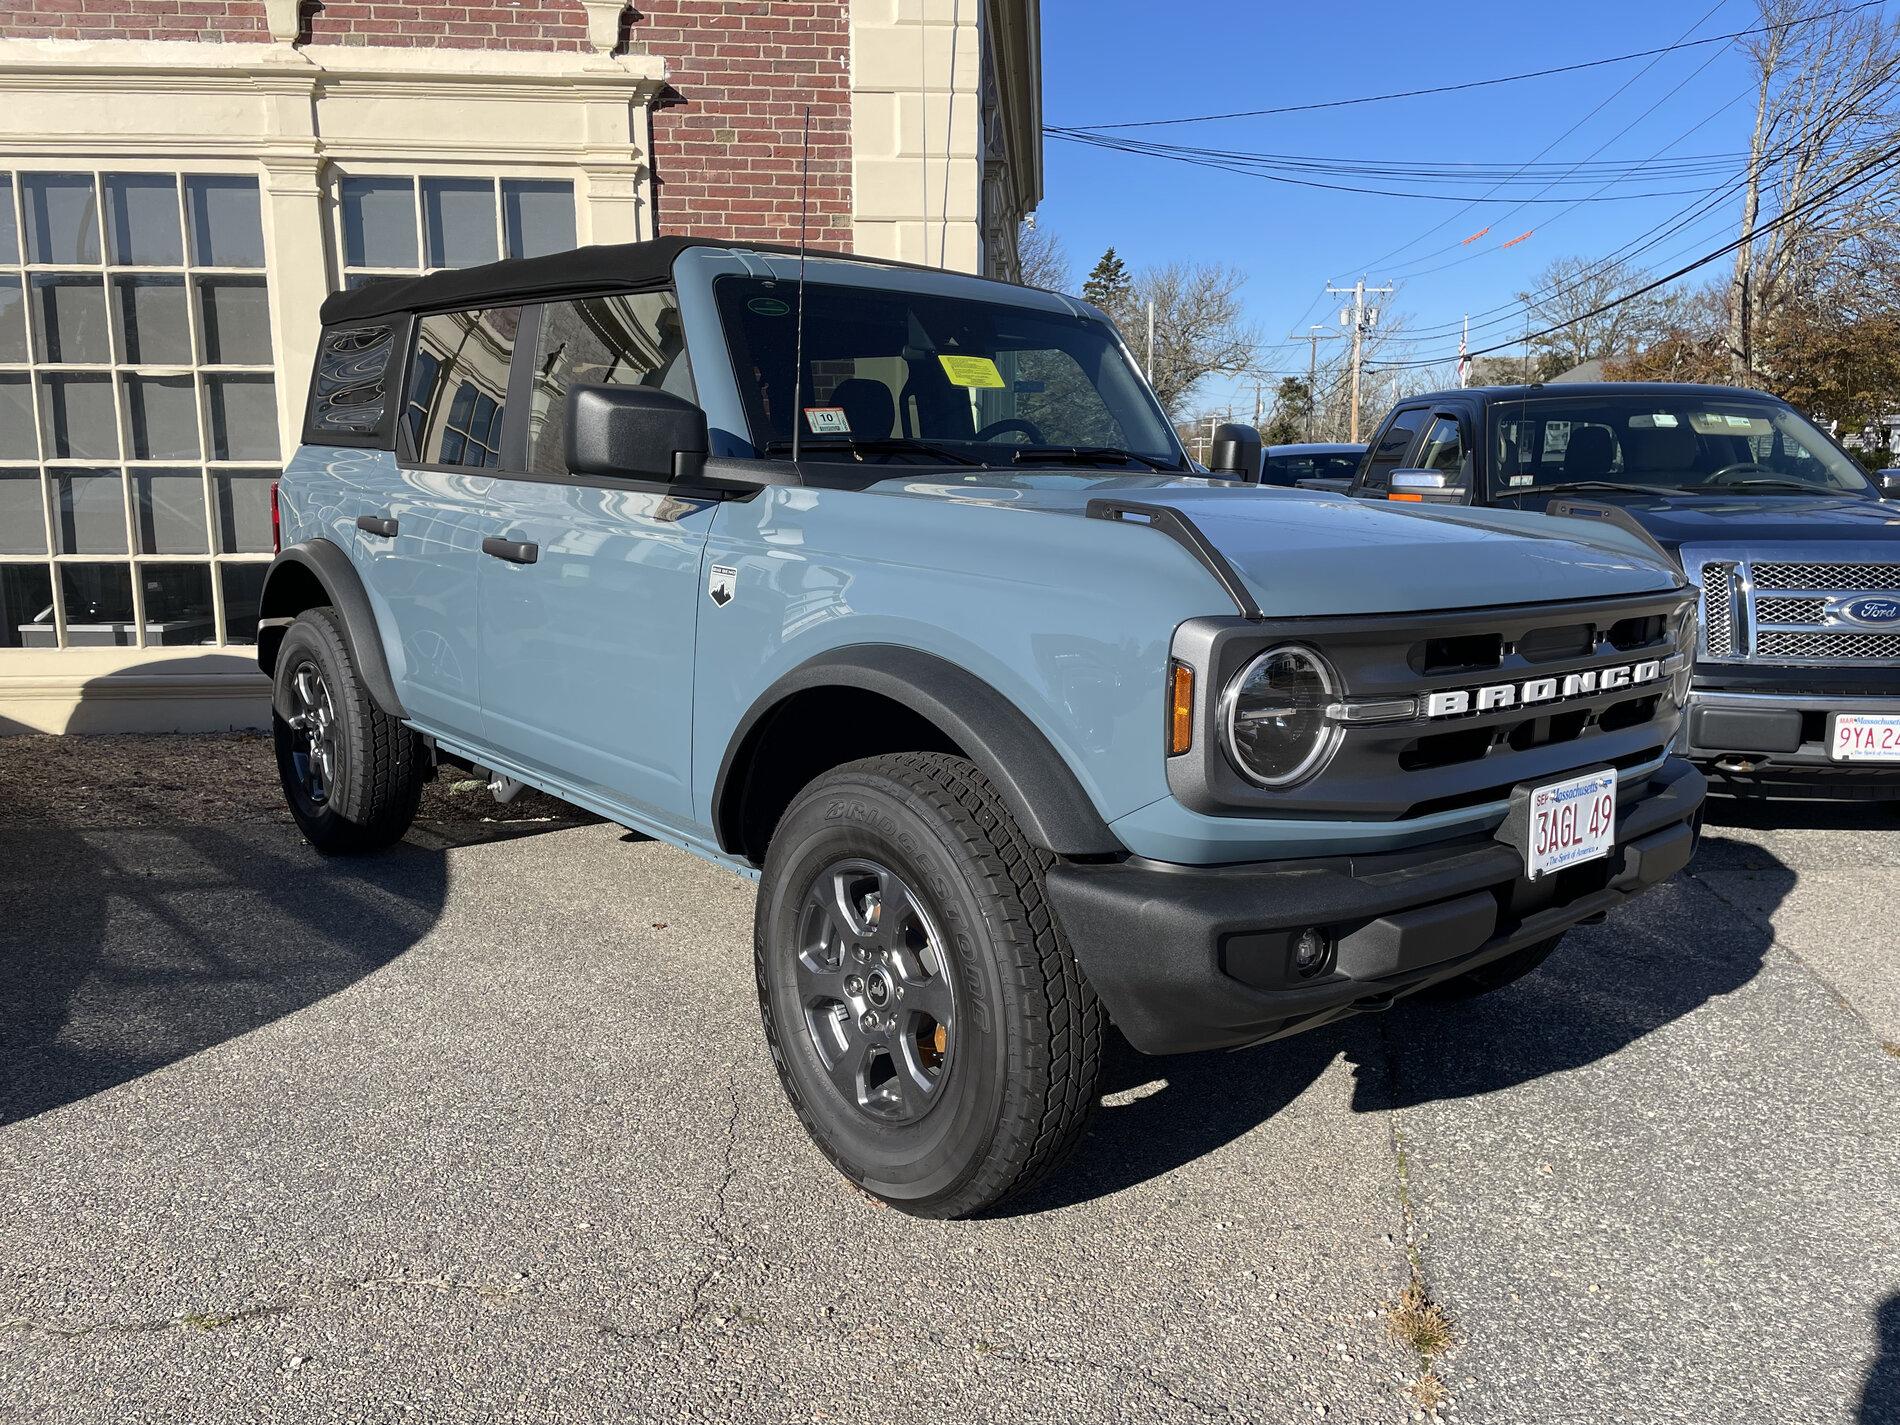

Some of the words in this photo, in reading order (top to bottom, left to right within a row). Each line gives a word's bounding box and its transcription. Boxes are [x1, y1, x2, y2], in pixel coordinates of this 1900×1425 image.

[820, 413, 834, 422] 10
[1861, 602, 1897, 618] Ford
[1428, 660, 1660, 717] BRONCO
[1840, 727, 1875, 749] 9YA
[1536, 803, 1583, 856] 3AGL
[1589, 794, 1612, 838] 49
[825, 800, 991, 1034] BRIDGESTONE
